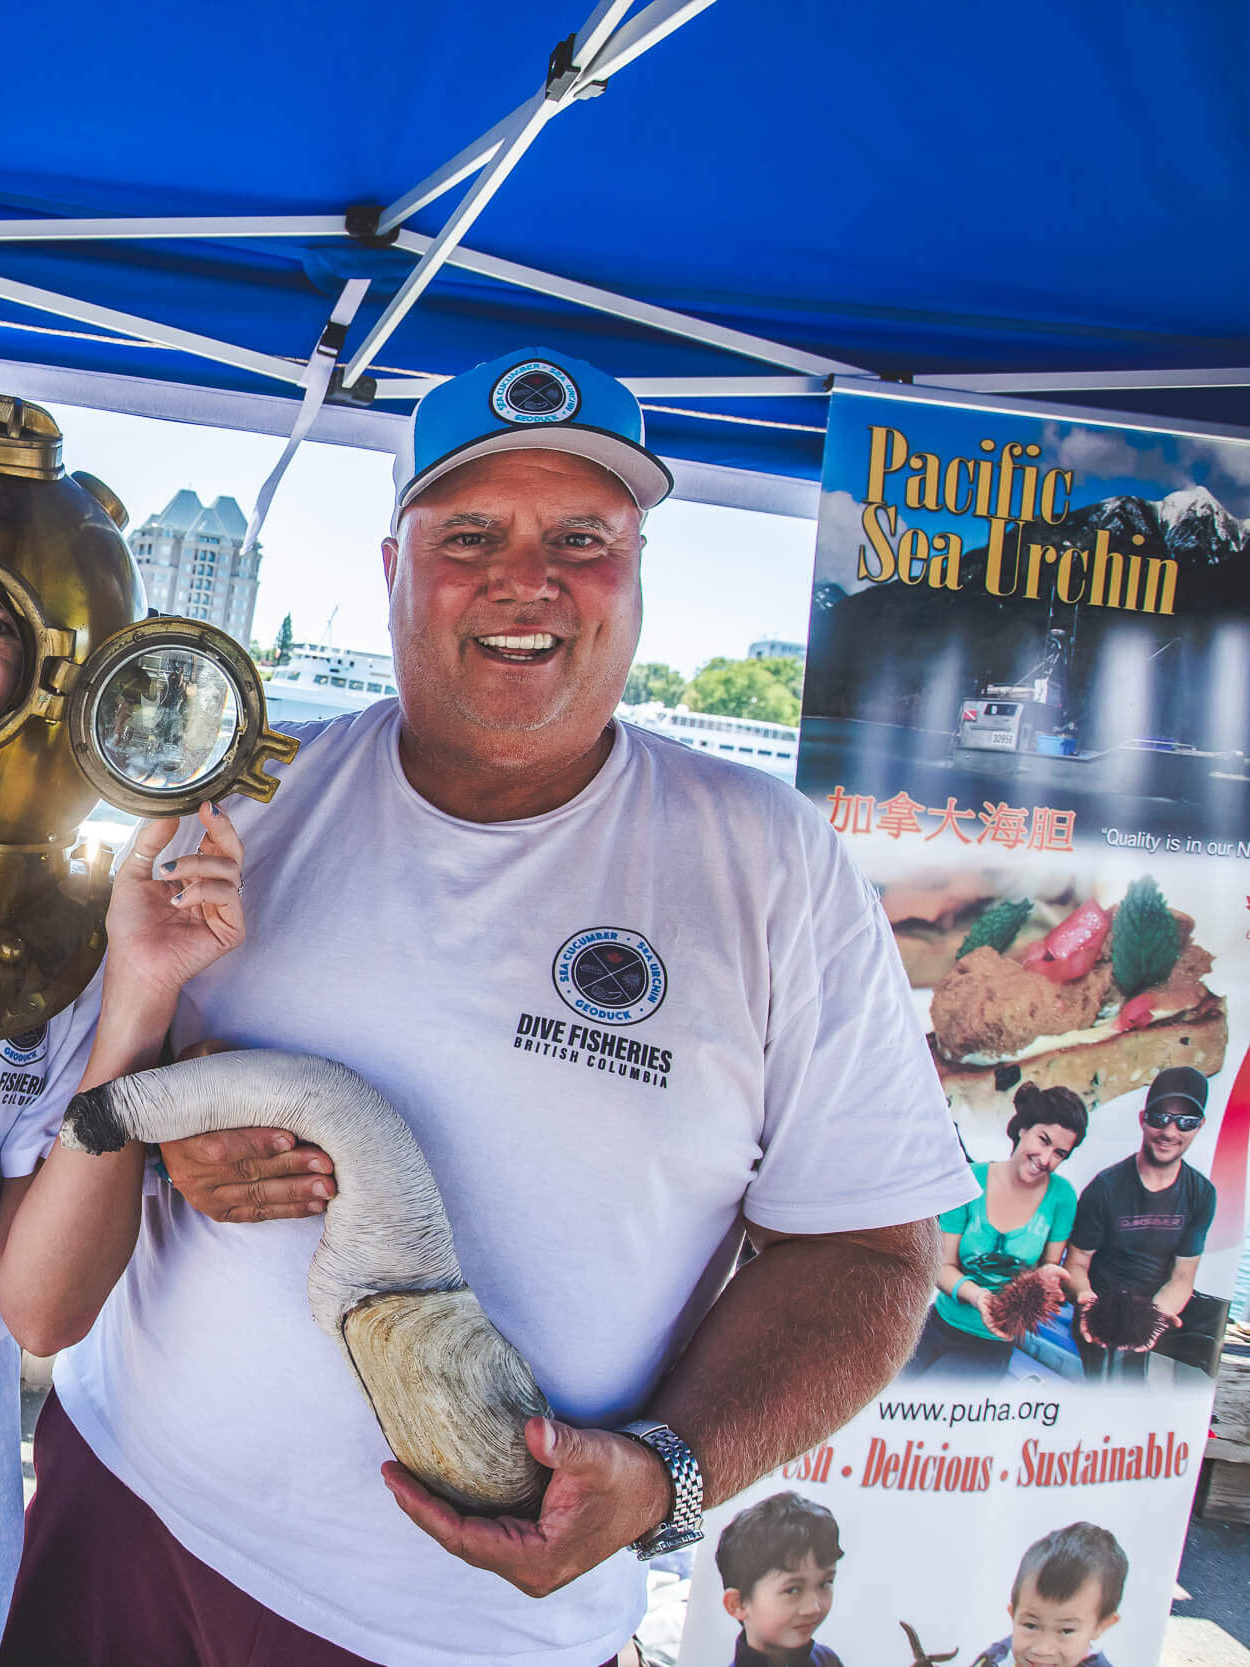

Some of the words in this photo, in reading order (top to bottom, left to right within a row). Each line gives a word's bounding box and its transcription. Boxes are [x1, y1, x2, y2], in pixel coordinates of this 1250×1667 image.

[862, 425, 1074, 525] Pacific
[857, 503, 964, 592] Sea
[984, 517, 1180, 616] Urchin
[826, 784, 1077, 852] 加拿大海胆
[1165, 834, 1181, 851] is
[1186, 836, 1202, 853] in
[1207, 842, 1232, 855] our
[1236, 841, 1250, 858] N
[563, 931, 618, 961] CUCUMBER
[636, 941, 654, 962] SEA
[558, 963, 570, 982] SEA
[647, 963, 662, 1004] URCHIN
[575, 999, 632, 1020] GEODUCK
[3, 1046, 38, 1062] GEODUCK
[516, 1013, 567, 1044] DIVE
[568, 1024, 673, 1074] FISHERIES
[513, 1036, 579, 1063] BRITISH
[587, 1054, 669, 1089] COLUMBIA
[879, 1398, 1060, 1428] www.puha.org
[779, 1441, 835, 1483] esh
[861, 1437, 994, 1492] Delicious
[1016, 1431, 1190, 1488] Sustainable
